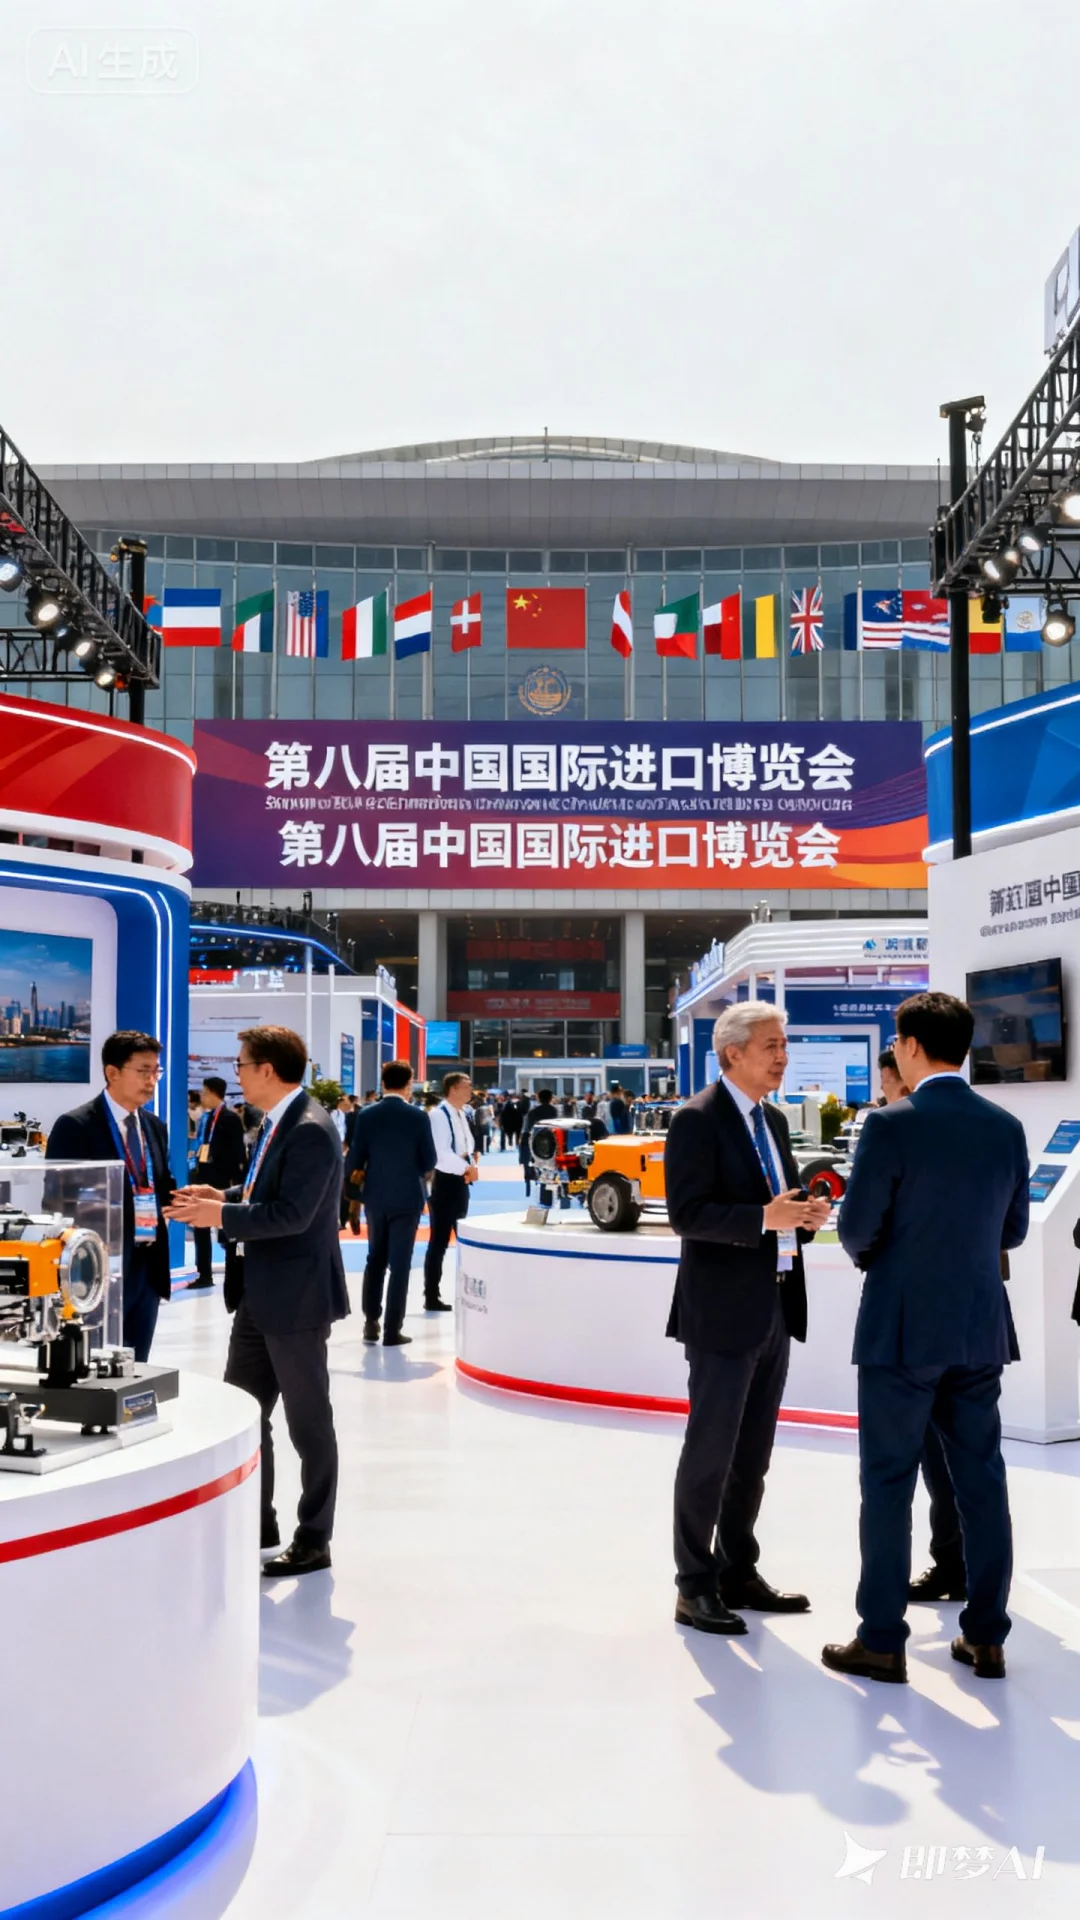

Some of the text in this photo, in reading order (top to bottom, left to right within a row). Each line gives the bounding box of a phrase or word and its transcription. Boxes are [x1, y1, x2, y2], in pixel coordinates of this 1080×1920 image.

[264, 741, 855, 792] 第八届中国国际进口博览会
[278, 821, 841, 869] 第八届中国国际进口博览会
